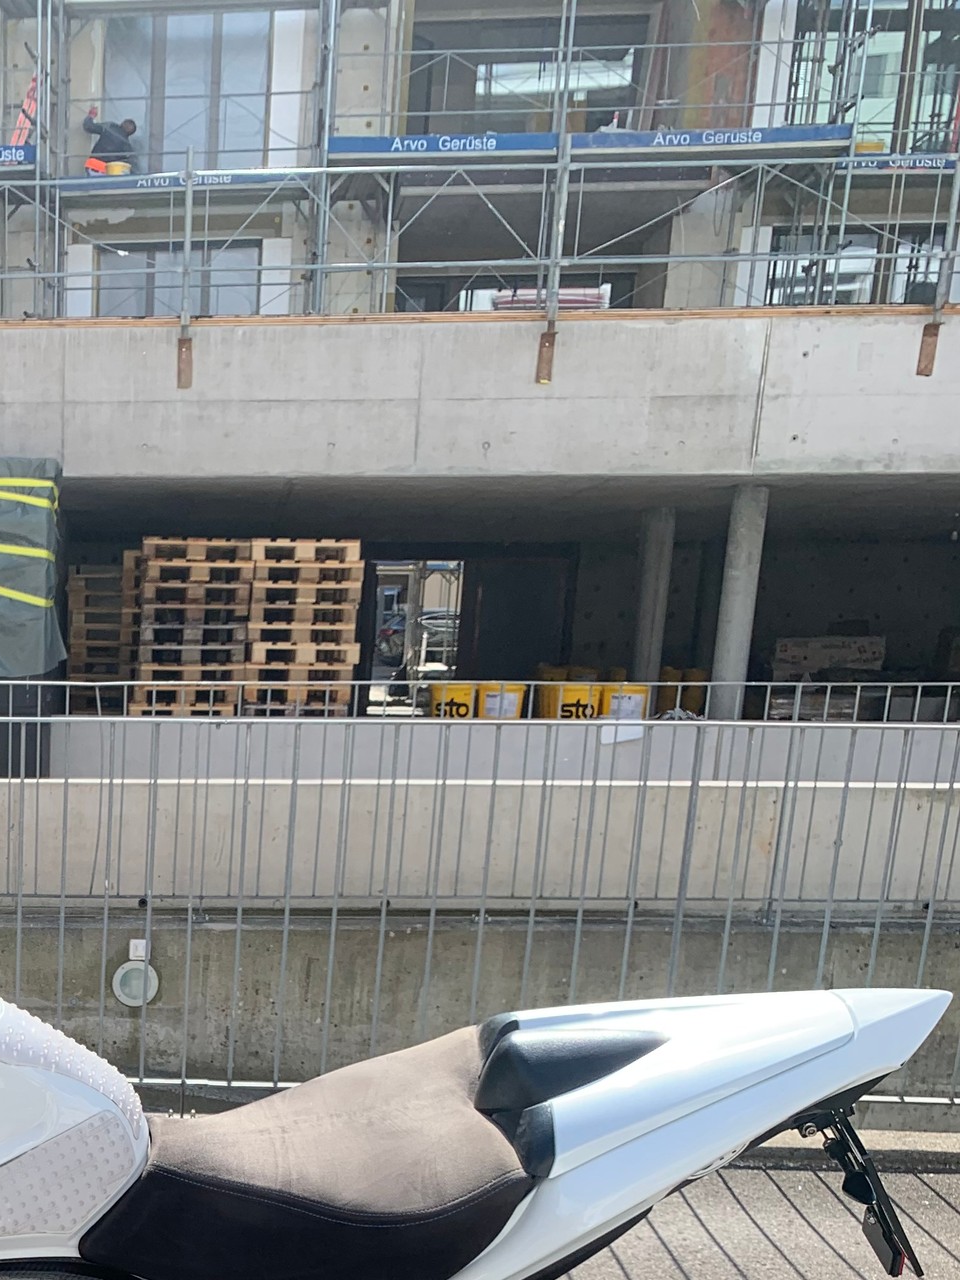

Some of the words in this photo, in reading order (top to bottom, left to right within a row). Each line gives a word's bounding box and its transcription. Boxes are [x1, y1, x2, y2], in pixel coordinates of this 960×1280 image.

[390, 137, 428, 152] Arvo
[438, 135, 497, 151] Gerüste
[652, 132, 691, 146] Arvo
[435, 697, 470, 718] sto
[560, 698, 595, 719] sto
